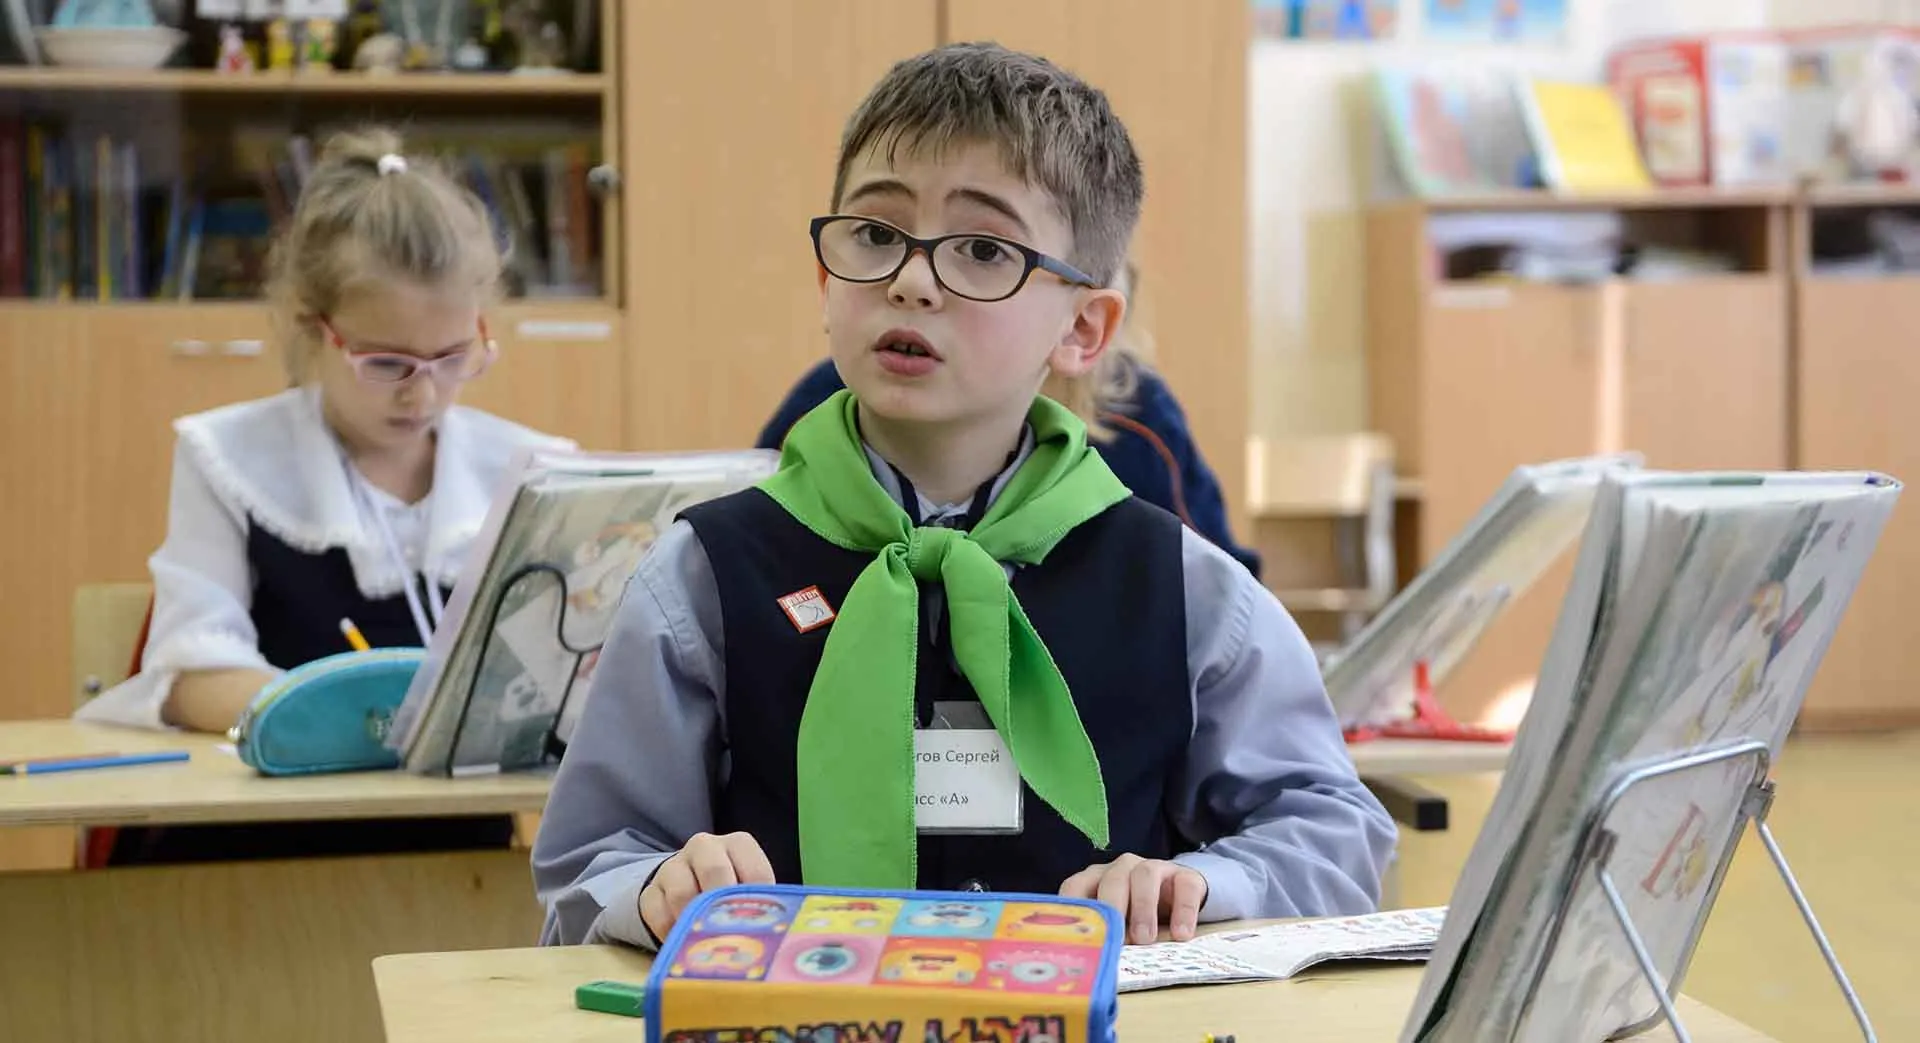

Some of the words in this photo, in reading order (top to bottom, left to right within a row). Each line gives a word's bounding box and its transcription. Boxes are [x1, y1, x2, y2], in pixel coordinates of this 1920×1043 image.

[914, 752, 941, 763] гов
[945, 749, 1000, 765] Сергей
[940, 793, 969, 806] «А»
